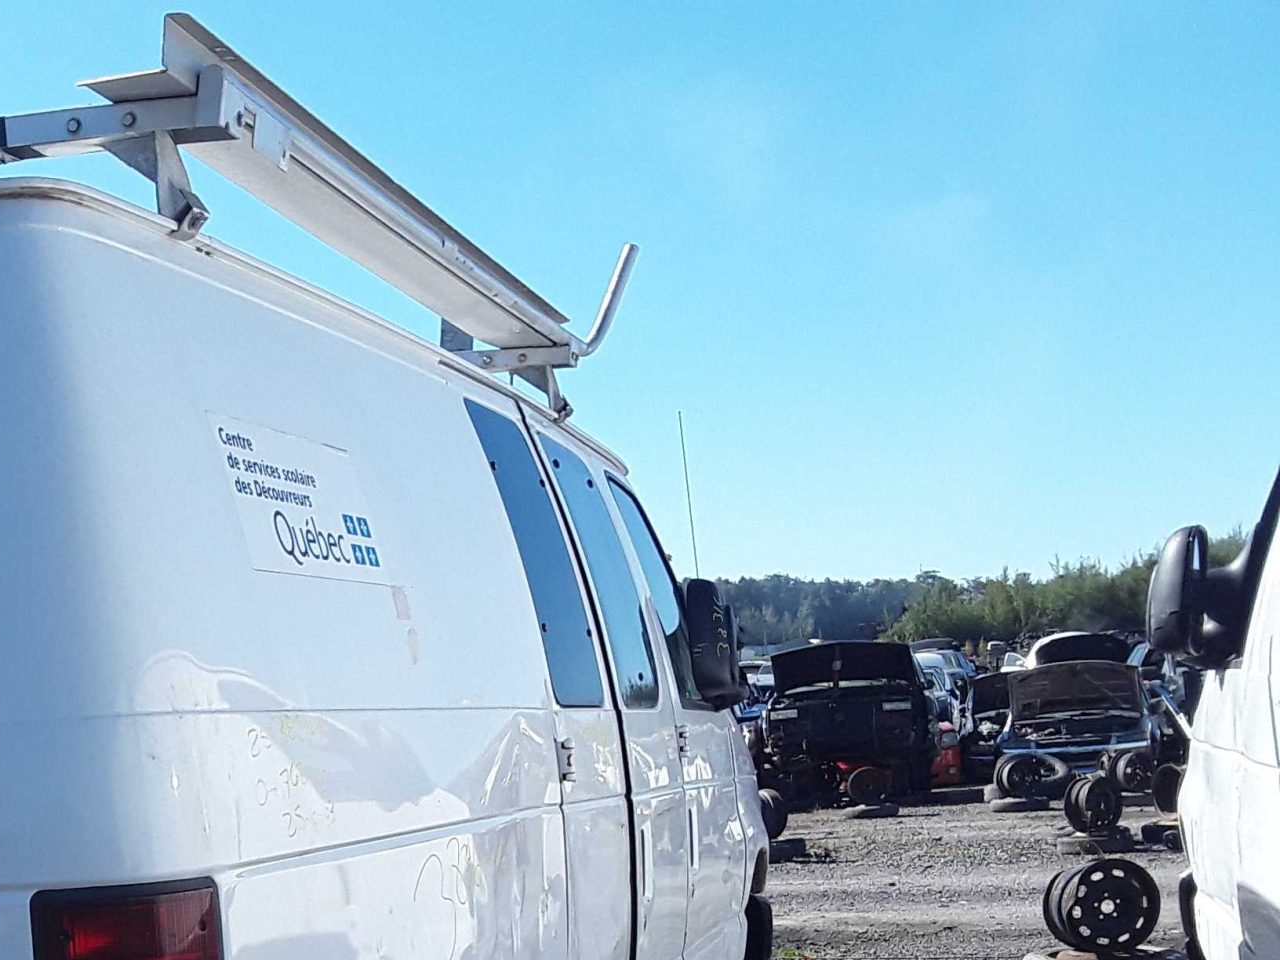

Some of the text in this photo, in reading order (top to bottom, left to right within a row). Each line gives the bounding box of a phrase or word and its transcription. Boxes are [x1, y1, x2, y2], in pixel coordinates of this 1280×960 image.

[217, 427, 253, 451] Centre
[226, 452, 317, 489] de services scolaire
[234, 476, 313, 508] des Découvreurs
[273, 510, 351, 566] Québec
